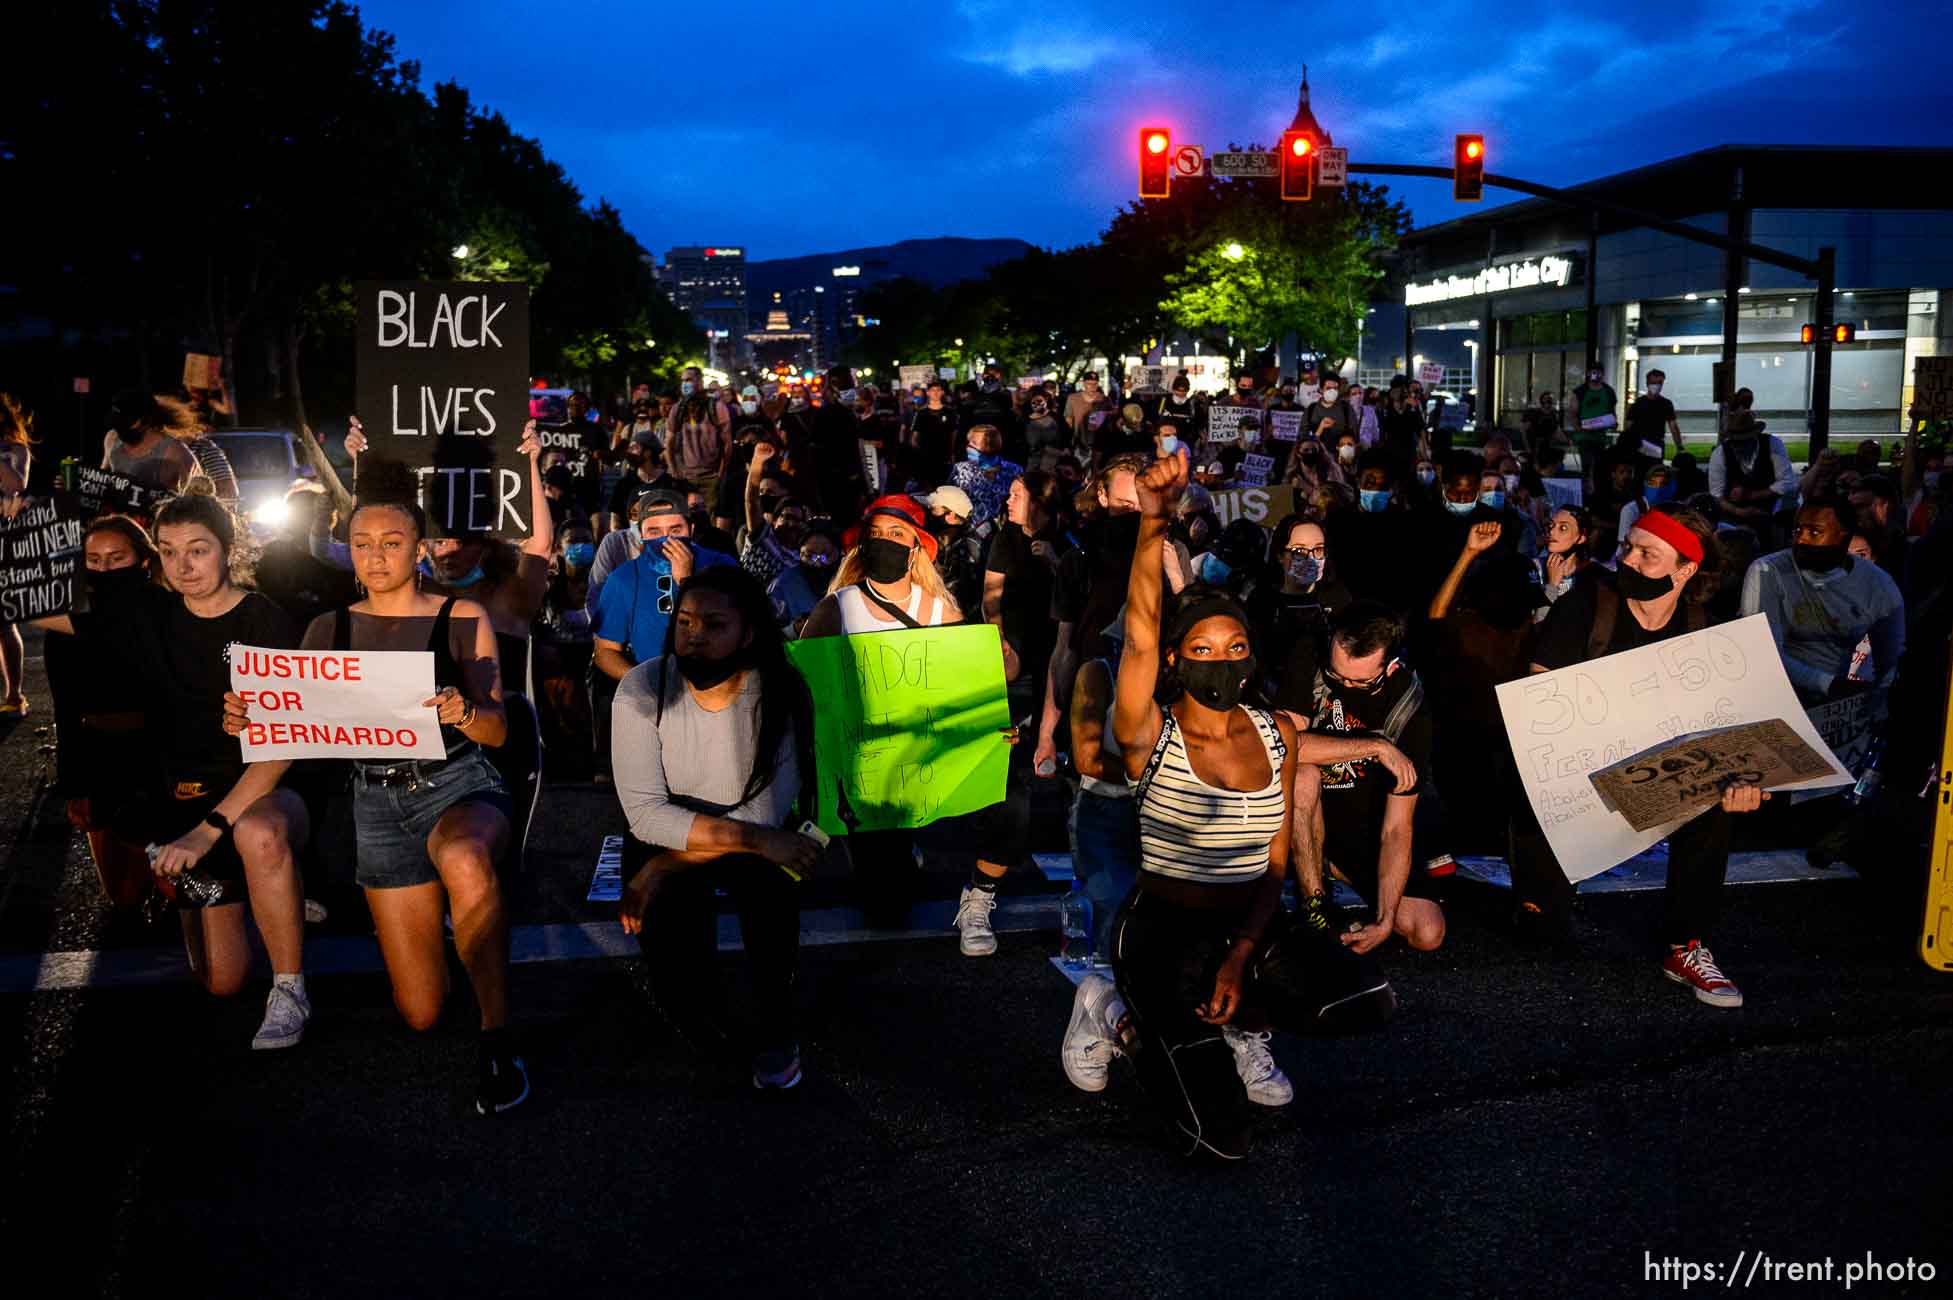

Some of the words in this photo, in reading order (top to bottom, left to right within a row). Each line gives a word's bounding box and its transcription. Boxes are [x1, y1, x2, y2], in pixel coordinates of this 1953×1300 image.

[1322, 150, 1342, 159] ONE
[1322, 160, 1342, 170] WAY
[377, 290, 508, 348] BLACK
[392, 384, 496, 436] LIVES
[540, 431, 583, 449] DONT
[414, 466, 528, 532] TTER
[12, 530, 40, 561] will
[50, 557, 75, 578] but
[1, 577, 74, 621] STAND!
[237, 652, 361, 681] JUSTICE
[239, 691, 303, 711] FOR
[247, 722, 417, 747] BERNARDO
[177, 781, 203, 793] NIKE
